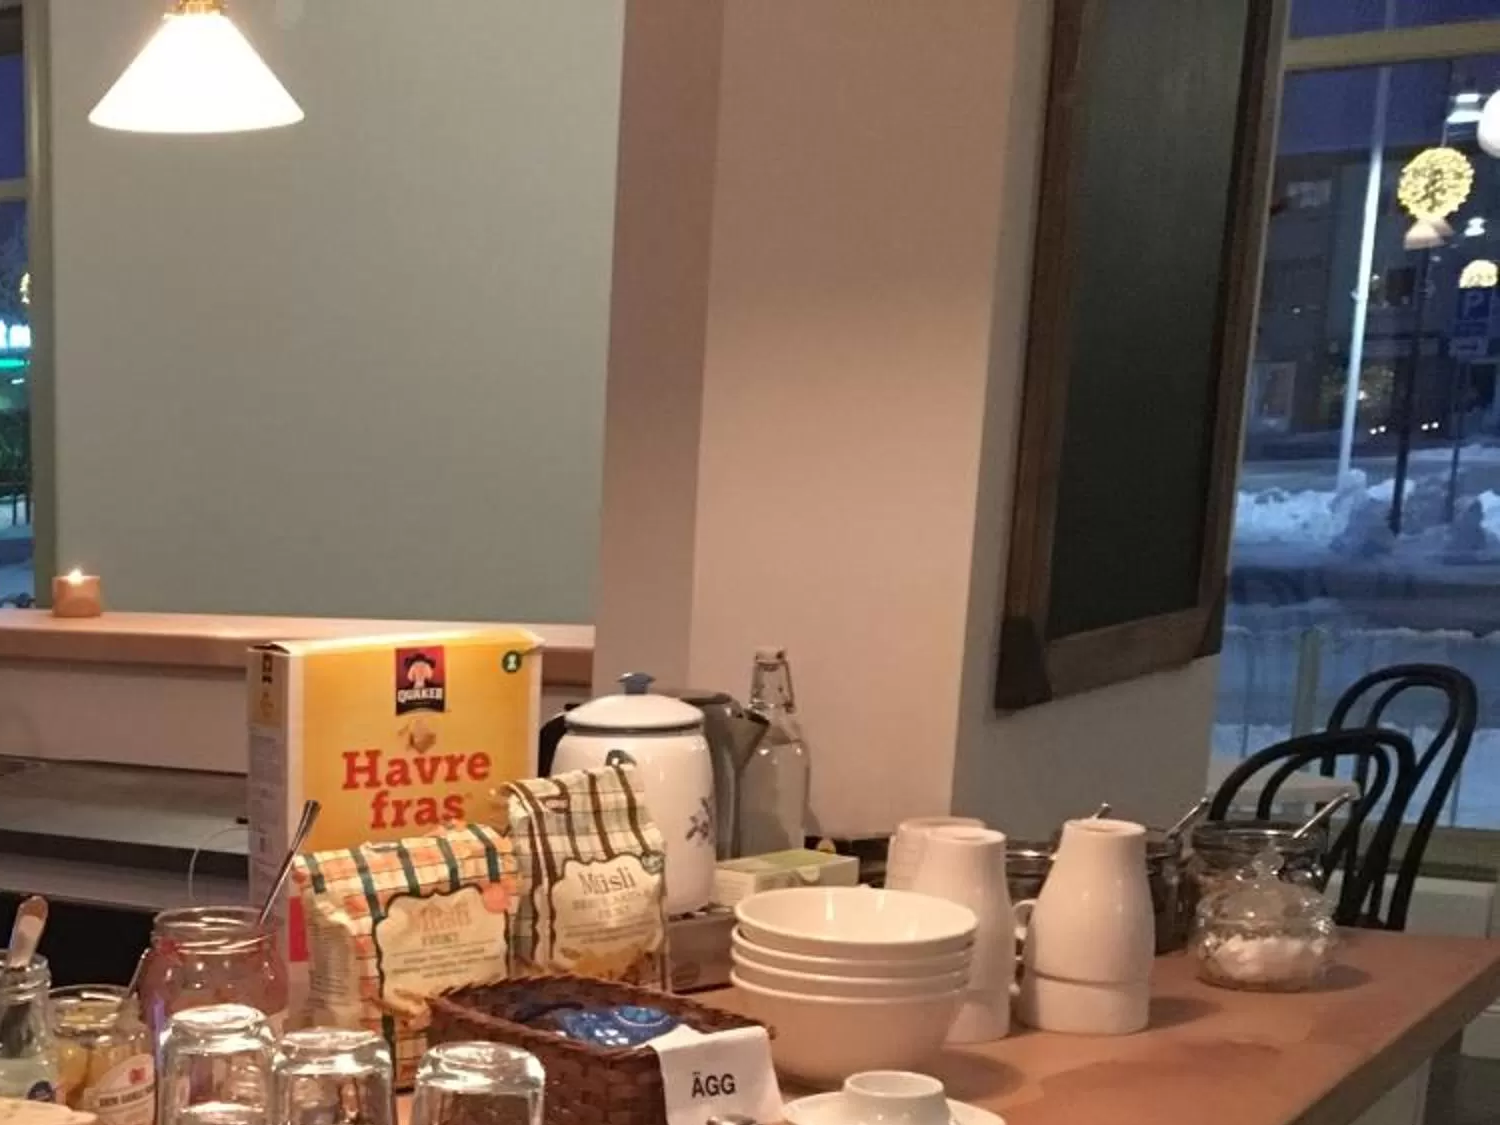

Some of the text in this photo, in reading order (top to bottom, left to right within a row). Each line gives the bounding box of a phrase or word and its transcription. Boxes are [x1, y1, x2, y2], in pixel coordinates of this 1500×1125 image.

[397, 687, 444, 704] QUAKER
[341, 748, 491, 790] Havre
[369, 792, 466, 830] fras
[690, 1071, 736, 1099] ÄGG
